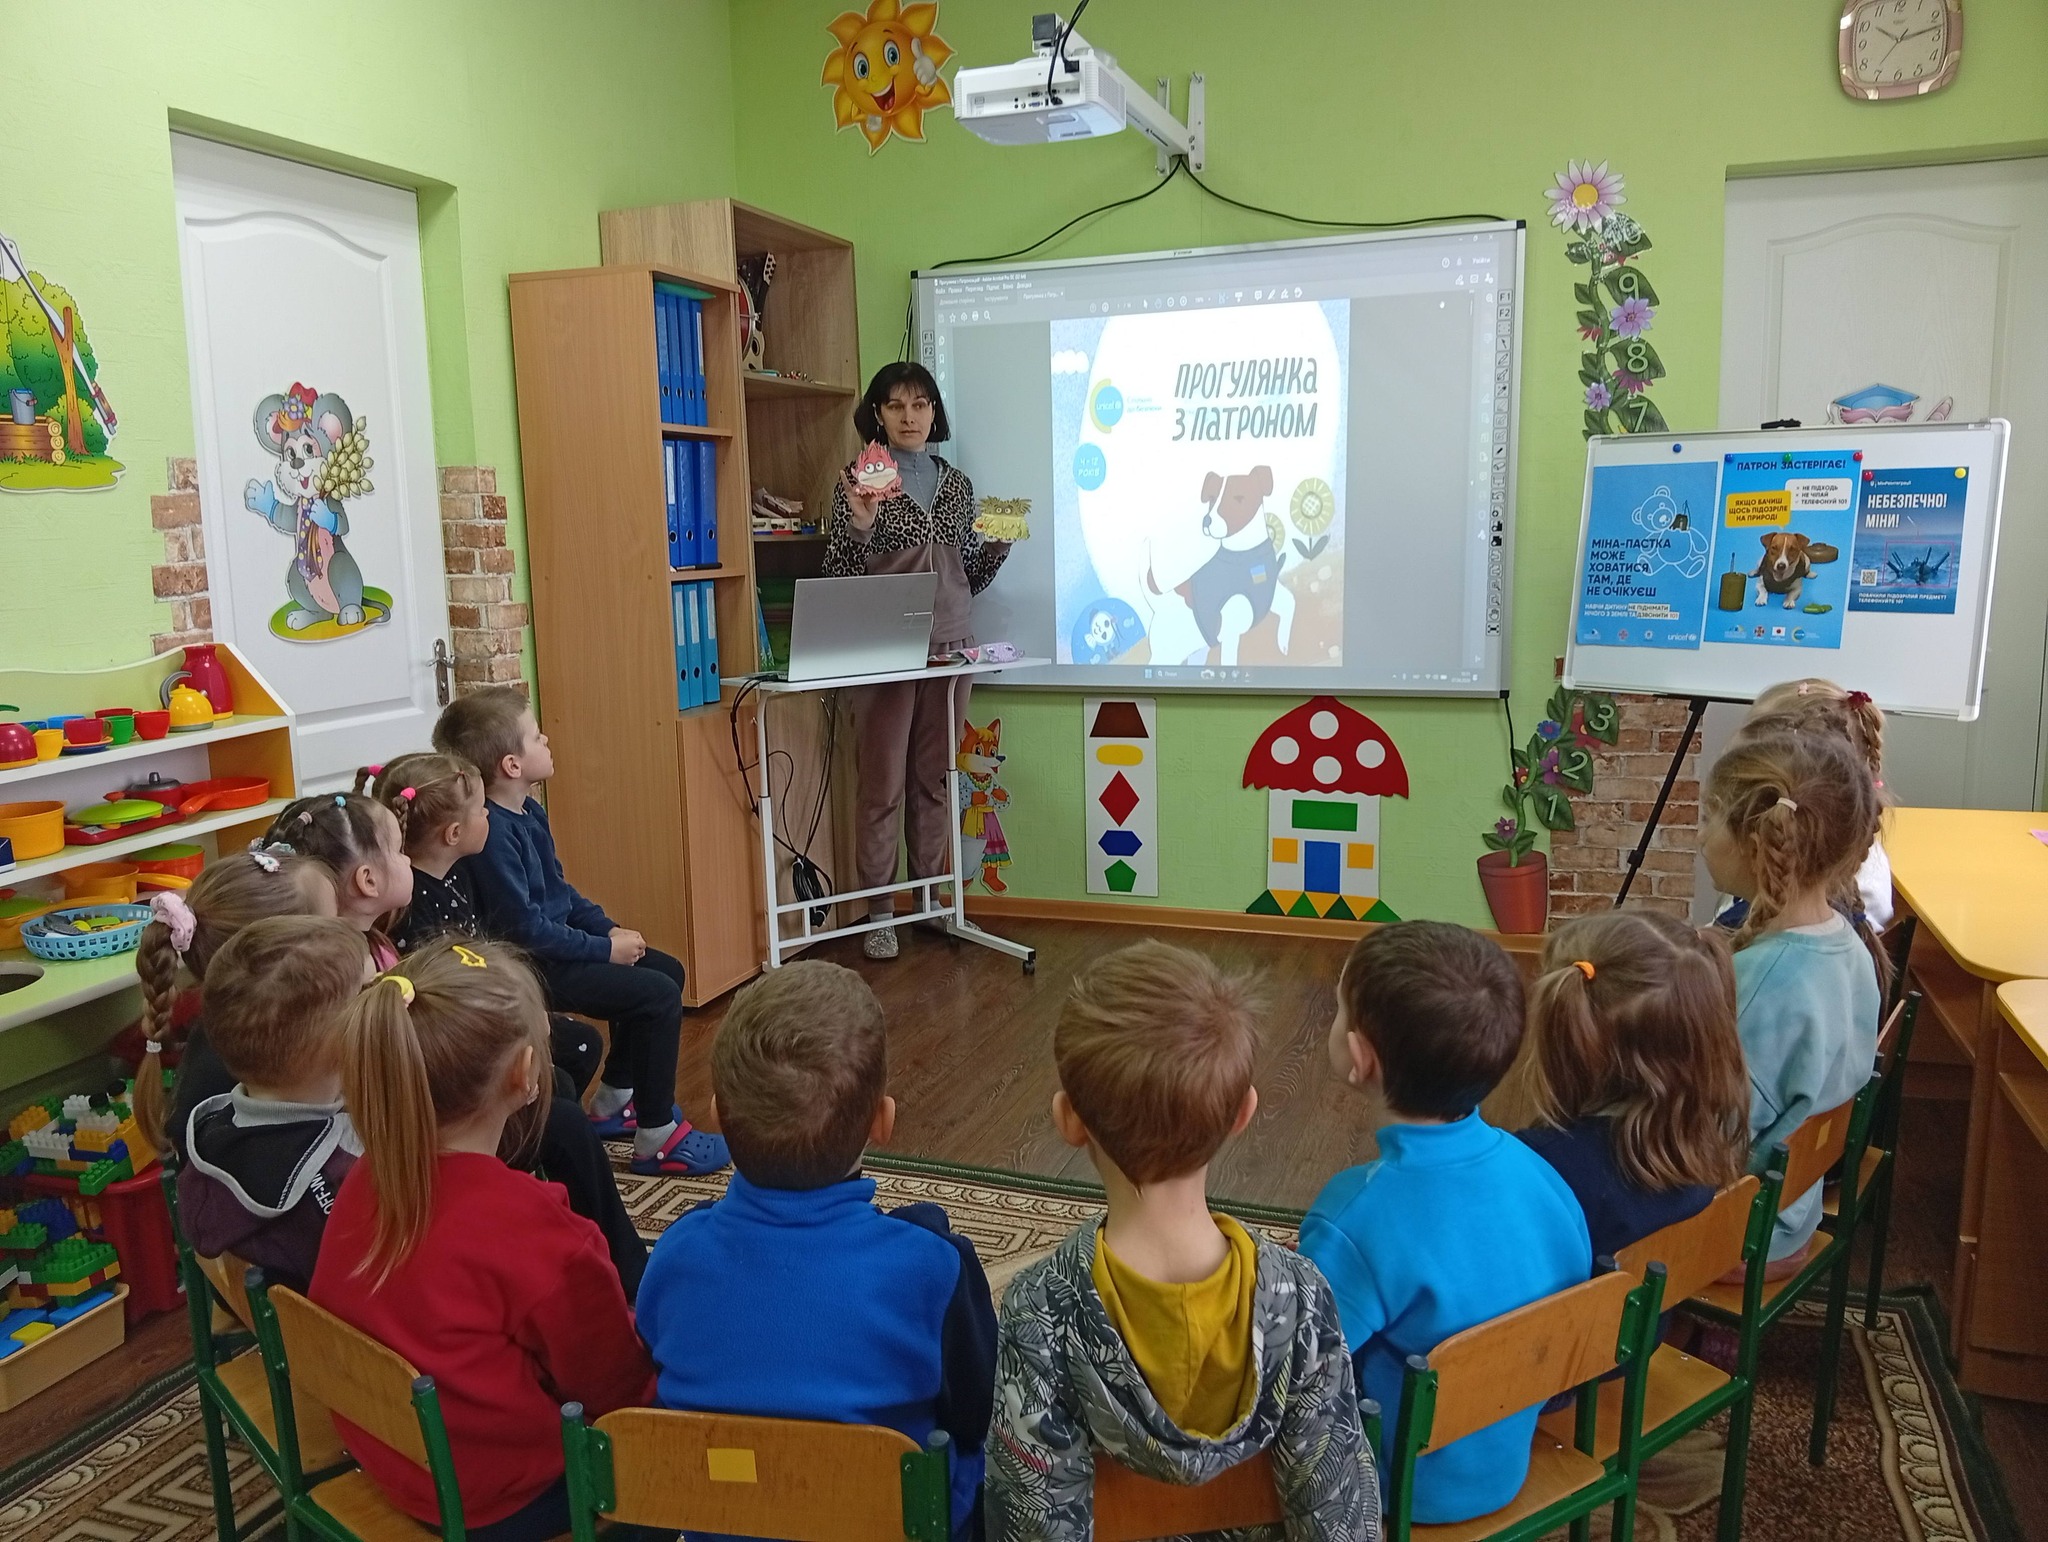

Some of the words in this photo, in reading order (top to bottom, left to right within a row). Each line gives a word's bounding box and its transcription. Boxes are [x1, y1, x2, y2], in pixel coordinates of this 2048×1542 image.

[1875, 5, 1886, 17] 11
[1894, 0, 1906, 13] 12
[1931, 11, 1940, 23] 2
[1859, 21, 1871, 33] 10
[1932, 30, 1941, 42] 3
[1859, 40, 1867, 51] 9
[1929, 49, 1939, 61] 4
[1859, 58, 1868, 71] 8
[1914, 64, 1923, 77] 5
[1874, 70, 1882, 82] 7
[1894, 69, 1902, 82] 6
[1618, 273, 1640, 300] 9
[1500, 293, 1510, 301] F1
[1499, 308, 1510, 317] F2
[924, 333, 933, 341] F1
[925, 346, 934, 355] F2
[1627, 342, 1649, 374] 8
[1629, 402, 1649, 433] 7
[1736, 461, 1777, 471] ПАТРОН
[1781, 460, 1846, 470] ЗАСТЕРІГАЄ!
[1758, 498, 1783, 506] БАЧИШ
[1867, 493, 1948, 509] НЕБЕЗПЕЧНО!
[1729, 507, 1751, 515] ЩОСЬ
[1752, 505, 1788, 514] ПІДОЗРІЛЕ
[1747, 514, 1778, 522] ПРИРОДІ
[1865, 513, 1900, 529] МІНИ!
[1591, 538, 1671, 549] МІНА-ПАСТКА
[1590, 551, 1625, 561] МОЖЕ
[1588, 562, 1649, 573] ХОВАТИСЯ
[1588, 575, 1614, 586] ТАМ,
[1616, 575, 1631, 586] ДЕ
[1586, 586, 1600, 597] НЕ
[1603, 586, 1656, 597] ОЧІКУЄШ
[1668, 632, 1688, 641] unicef
[1589, 704, 1615, 731] 3
[1562, 751, 1588, 780] 2
[1548, 794, 1559, 821] 1
